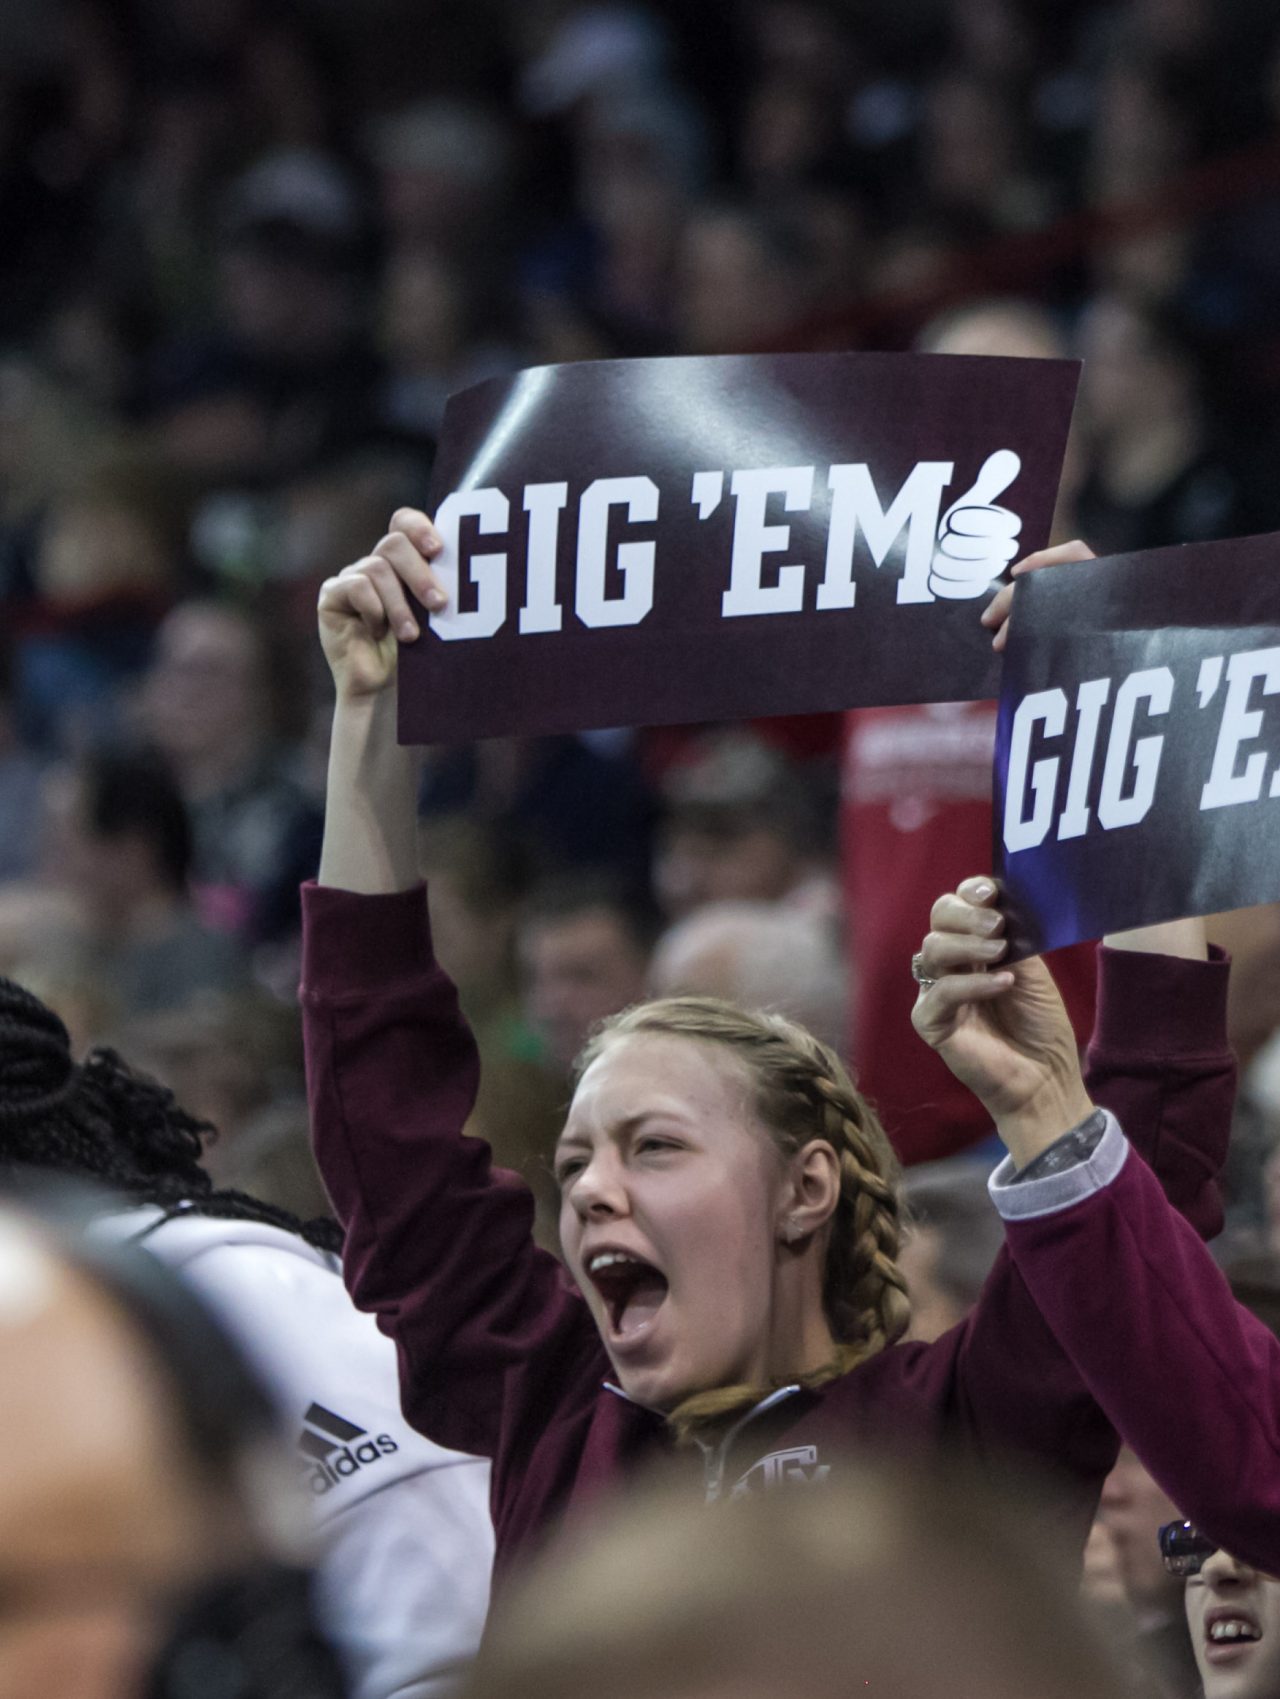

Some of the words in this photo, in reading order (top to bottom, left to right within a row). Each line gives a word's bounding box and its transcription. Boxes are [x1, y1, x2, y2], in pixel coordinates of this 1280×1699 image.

[429, 475, 660, 641] GIG
[691, 461, 955, 618] 'EM
[1003, 666, 1175, 854] GIG
[307, 1433, 399, 1496] didas
